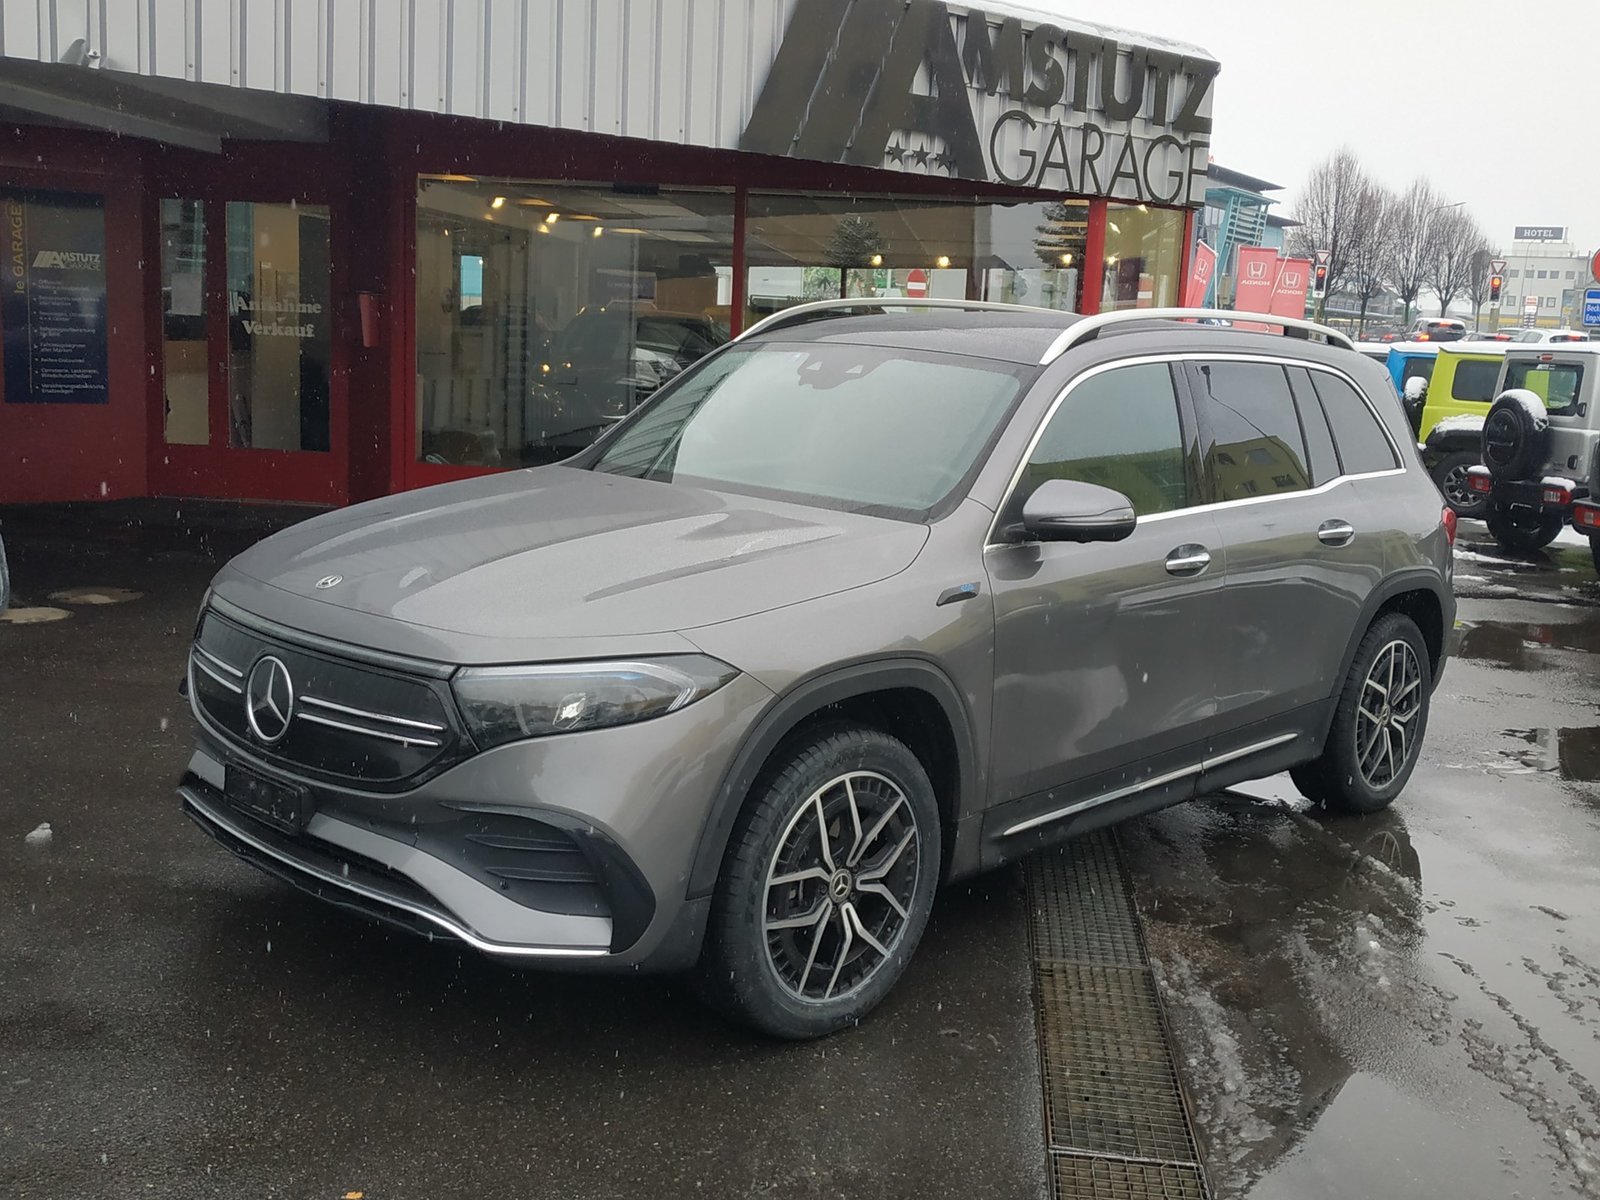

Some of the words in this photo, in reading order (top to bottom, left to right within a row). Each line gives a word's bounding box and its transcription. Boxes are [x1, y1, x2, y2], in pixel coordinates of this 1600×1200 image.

[842, 0, 1221, 180] AMSTUTZ
[990, 110, 1209, 208] GARAGE
[11, 204, 24, 277] GARAGE
[1523, 229, 1554, 237] HOTEL
[242, 320, 315, 337] Verkauf
